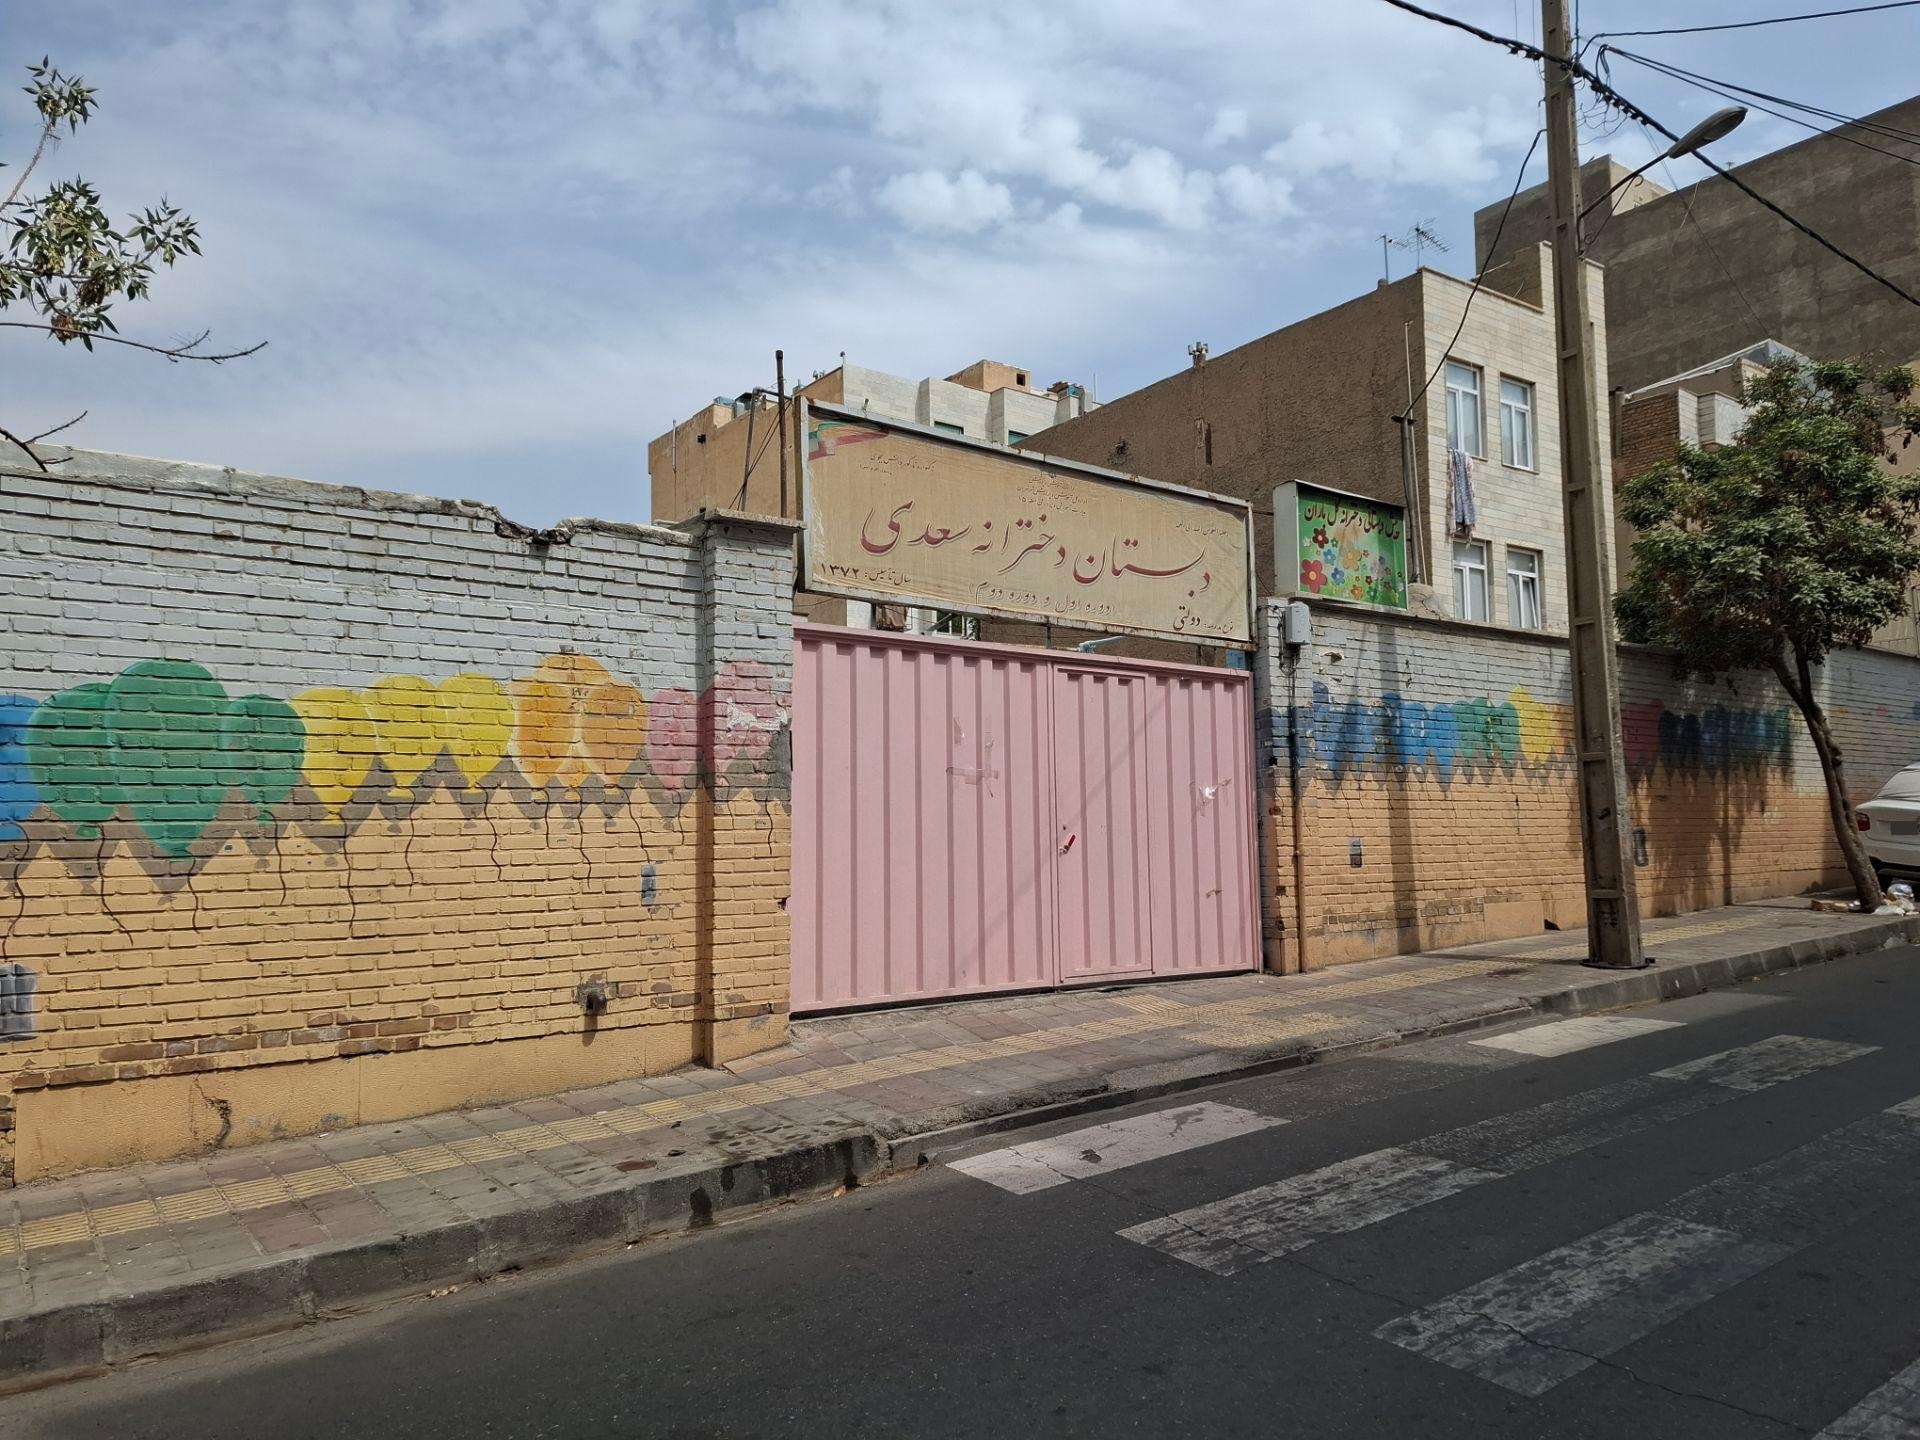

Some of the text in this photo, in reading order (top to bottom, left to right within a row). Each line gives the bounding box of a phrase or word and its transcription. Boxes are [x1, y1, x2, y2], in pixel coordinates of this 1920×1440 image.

[1304, 503, 1327, 529] باران
[860, 500, 1211, 599] دبستان دخترانه سعدی
[821, 562, 859, 580] ۱۳۷۲
[893, 572, 912, 586] سال
[1173, 605, 1201, 632] دولتی
[1222, 620, 1234, 634] نوع
